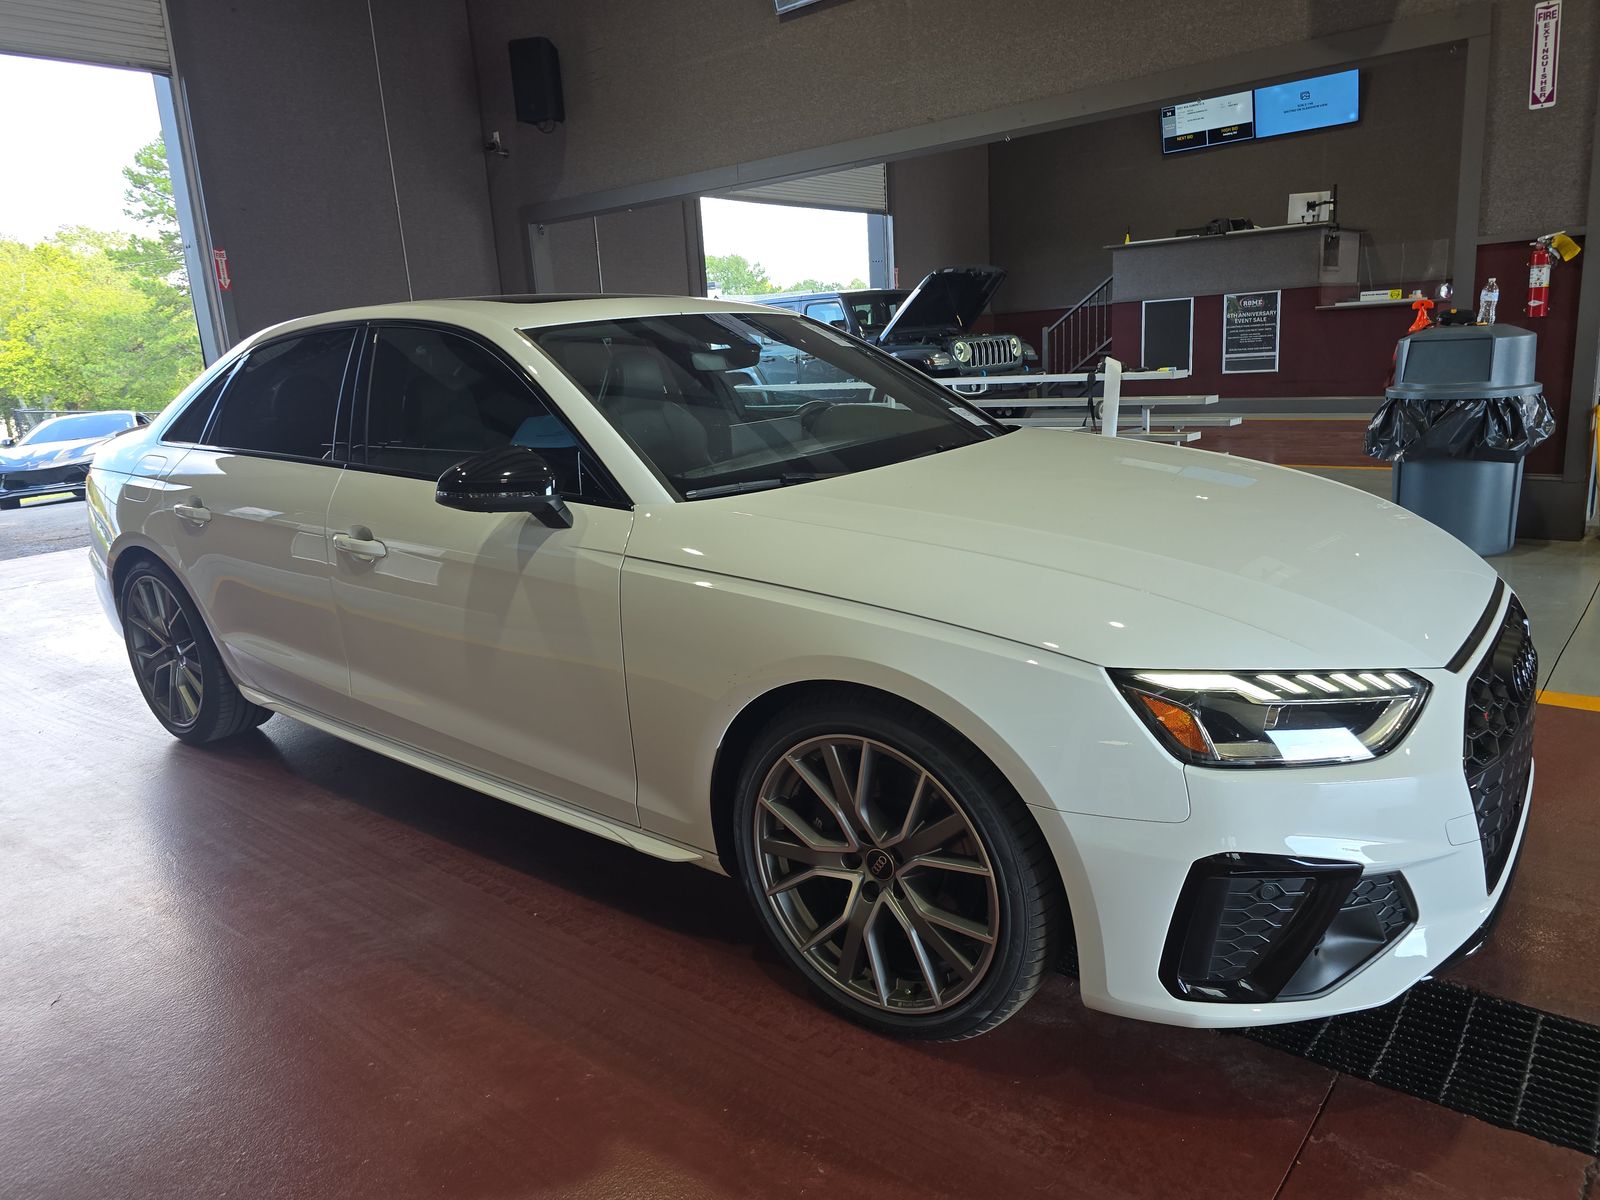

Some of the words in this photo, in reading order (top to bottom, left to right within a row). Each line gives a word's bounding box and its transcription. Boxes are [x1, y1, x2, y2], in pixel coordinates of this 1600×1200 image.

[1538, 10, 1557, 22] FIRE
[1539, 22, 1550, 99] EXTINGUISHER
[1243, 299, 1263, 307] ROME
